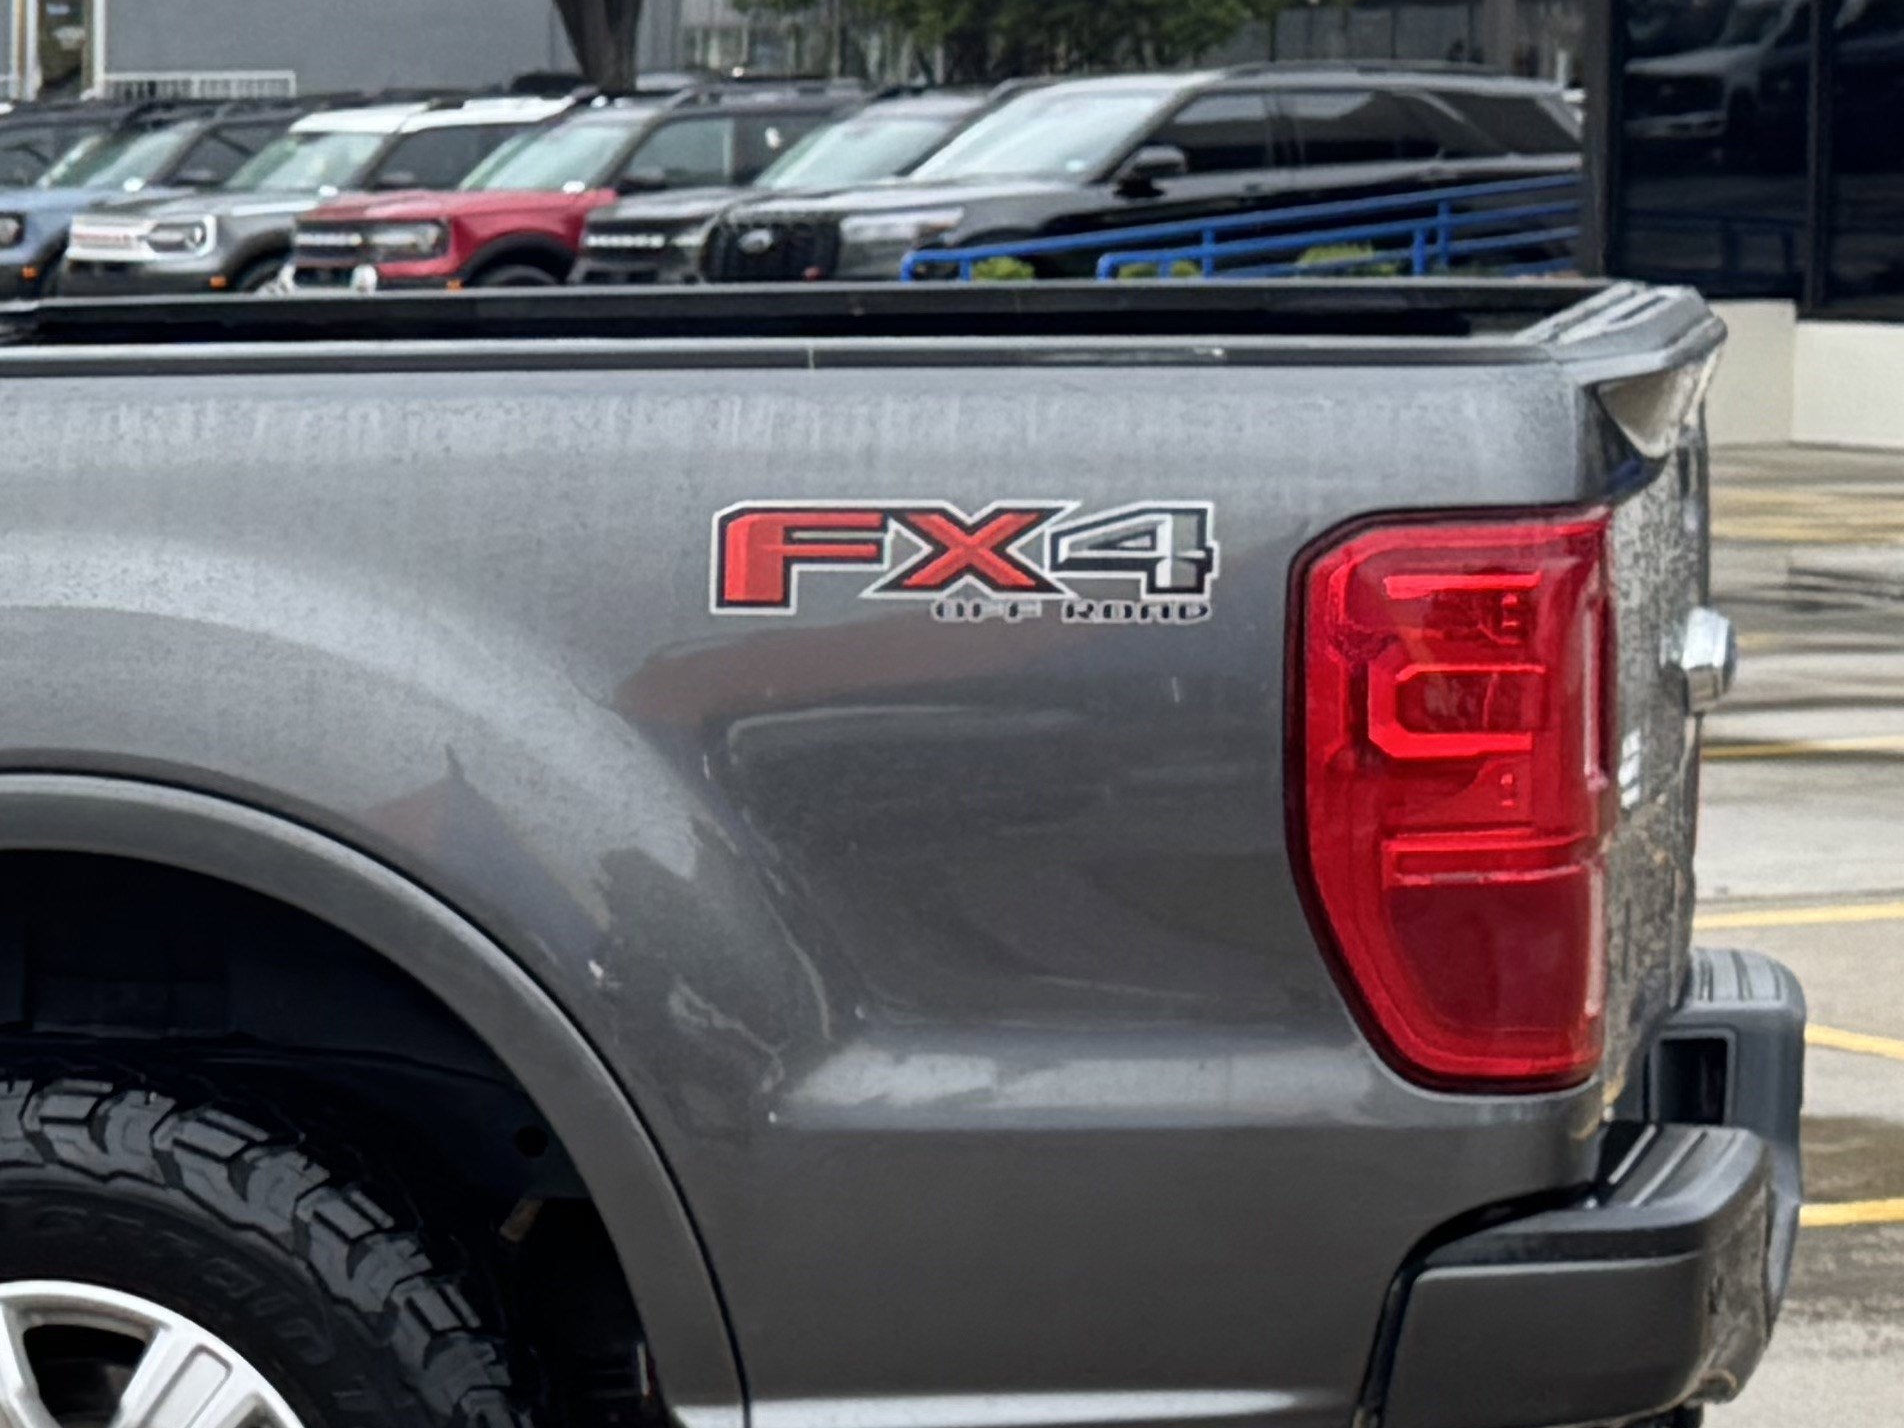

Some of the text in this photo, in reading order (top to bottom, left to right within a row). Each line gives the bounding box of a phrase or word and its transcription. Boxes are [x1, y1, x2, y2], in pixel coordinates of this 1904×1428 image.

[710, 499, 1220, 616] FX4
[931, 598, 1212, 625] OFF ROAD
